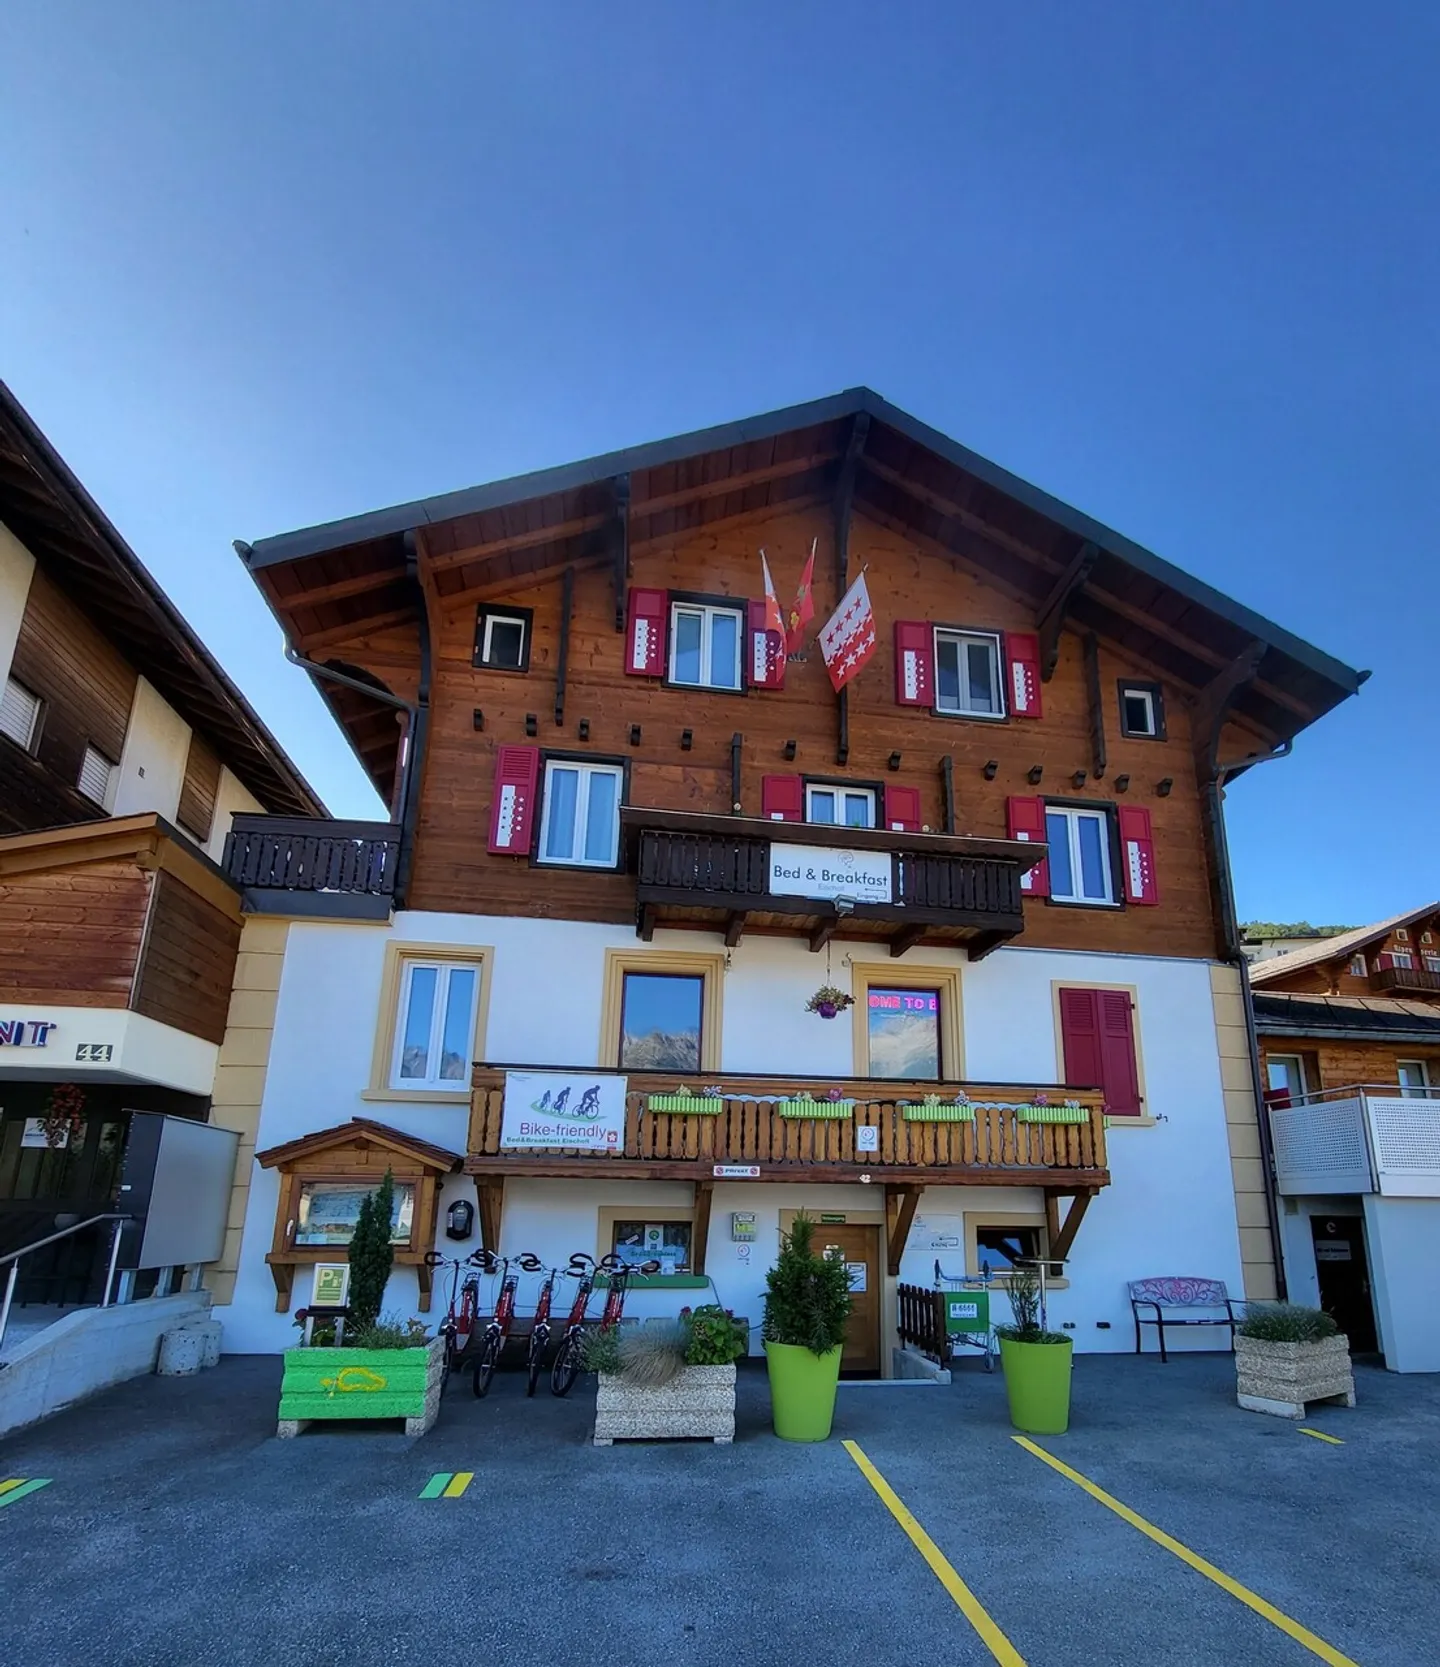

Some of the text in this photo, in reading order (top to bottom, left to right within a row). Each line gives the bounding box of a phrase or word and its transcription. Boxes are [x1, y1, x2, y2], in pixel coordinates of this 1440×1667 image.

[774, 865, 888, 887] Bed & Breakfast
[903, 996, 924, 1009] TO
[78, 1044, 110, 1062] 44
[519, 1122, 607, 1140] Bike-friendly
